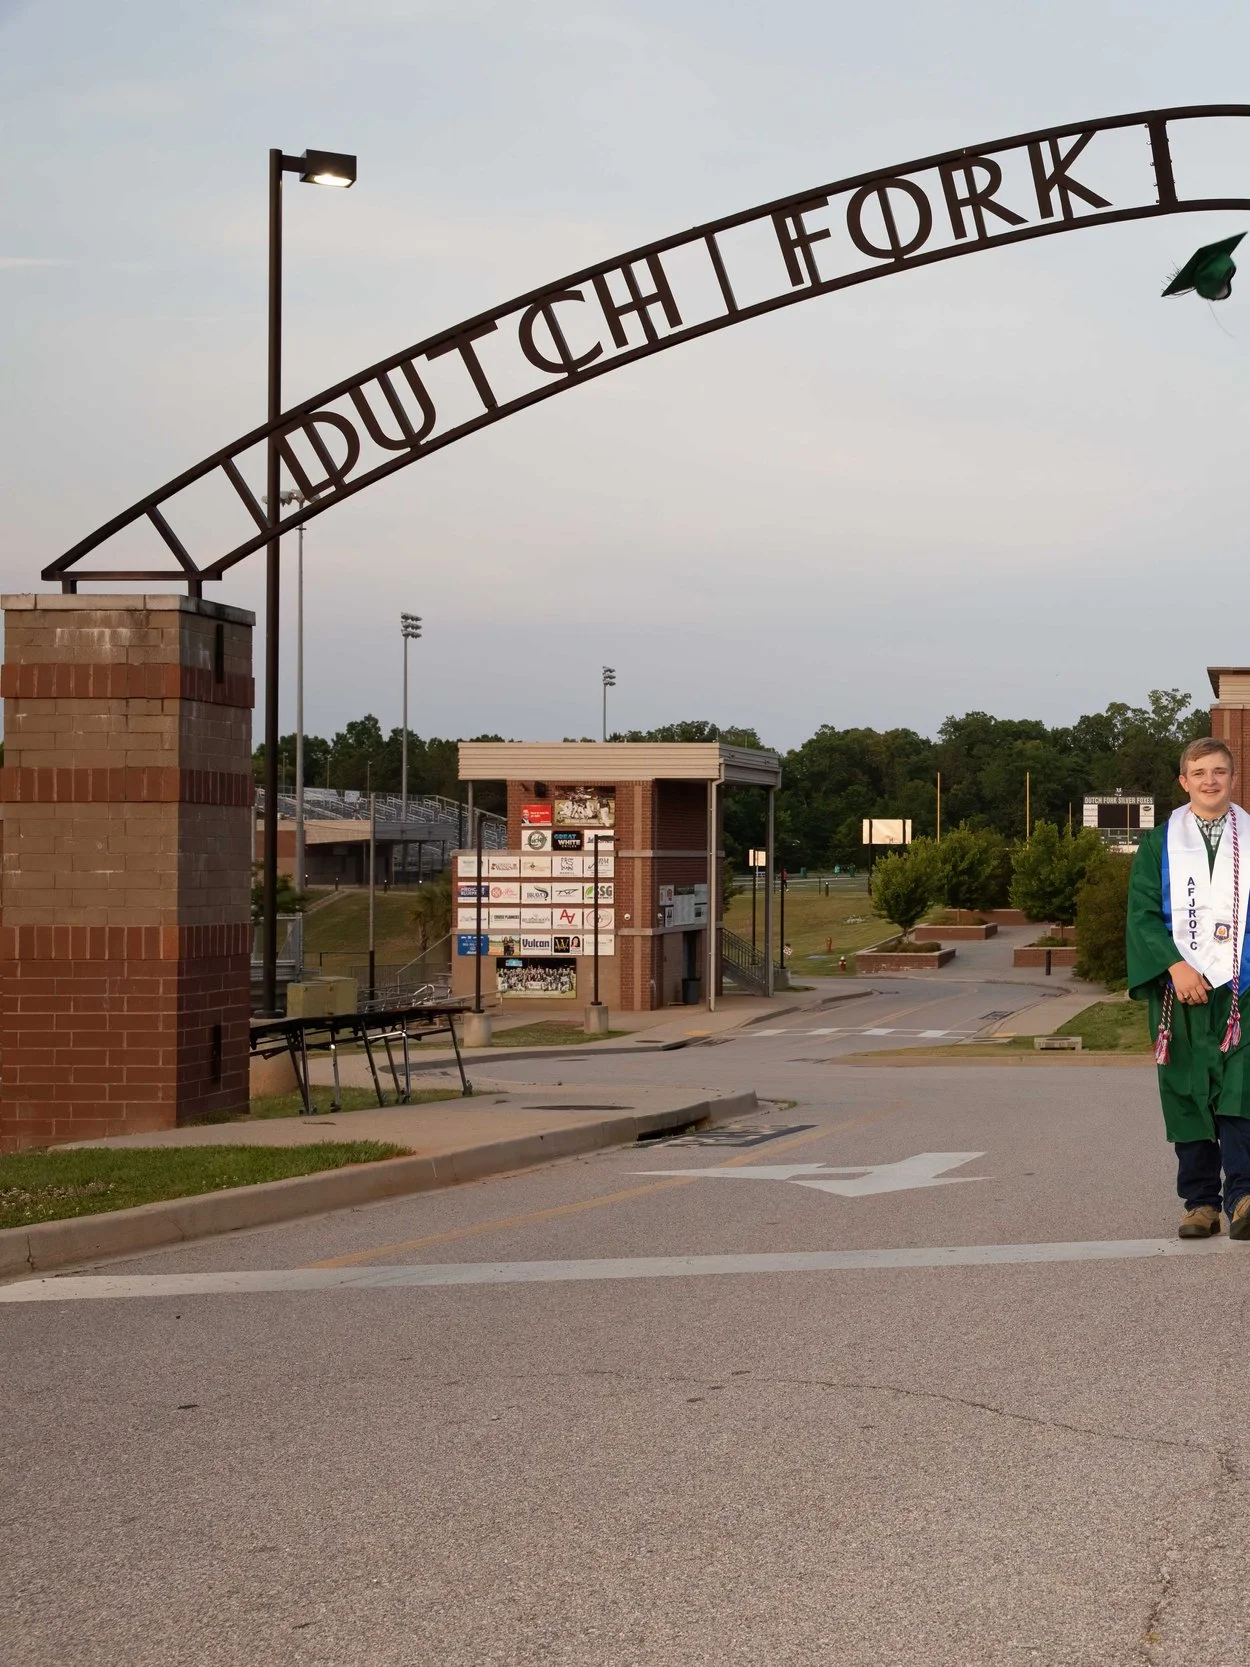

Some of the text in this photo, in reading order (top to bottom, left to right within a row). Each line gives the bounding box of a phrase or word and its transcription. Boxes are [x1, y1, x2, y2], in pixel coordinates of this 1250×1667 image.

[270, 254, 684, 501] DUTCH
[771, 131, 1112, 286] FORK
[597, 885, 613, 897] SG
[1187, 876, 1198, 951] AFJROTC
[522, 938, 550, 948] Vulcan
